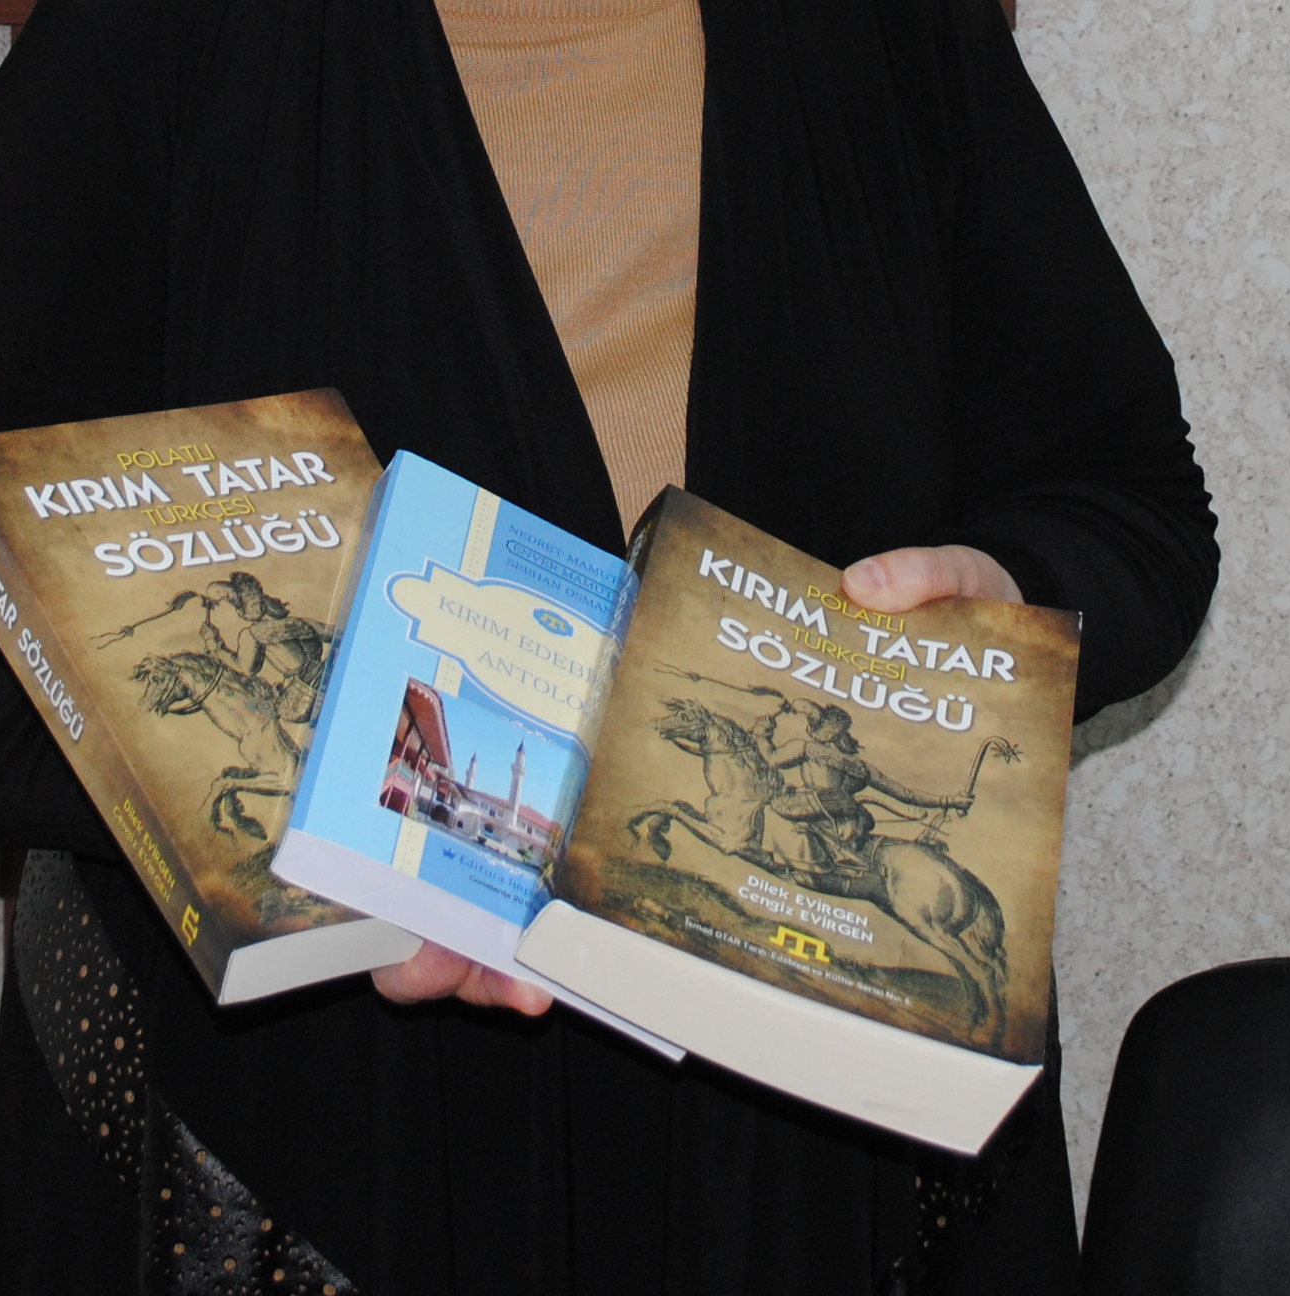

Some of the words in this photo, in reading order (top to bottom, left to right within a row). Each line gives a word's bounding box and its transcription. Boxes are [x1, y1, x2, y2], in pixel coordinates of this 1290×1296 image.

[25, 471, 172, 519] KIRIM
[182, 451, 335, 497] TATAR
[116, 443, 216, 471] POLATLI
[94, 509, 341, 577] SÖZLÜĞÜ
[510, 524, 564, 556] NEDRET
[567, 554, 619, 584] MAMUT
[513, 544, 558, 572] ENVER
[562, 569, 611, 599] MAMUT
[439, 595, 510, 641] KIRIM
[699, 548, 829, 637] KIRIM
[859, 624, 1015, 682] TATAR
[806, 584, 905, 633] POLATLI
[18, 628, 84, 741] SÖZLÜĞÜ
[716, 616, 974, 732] SÖZLÜĞÜ
[738, 886, 794, 917] Cengiz
[800, 909, 874, 944] EVİRGEN
[747, 874, 789, 901] Dilek
[795, 893, 868, 927] EVİRGEN
